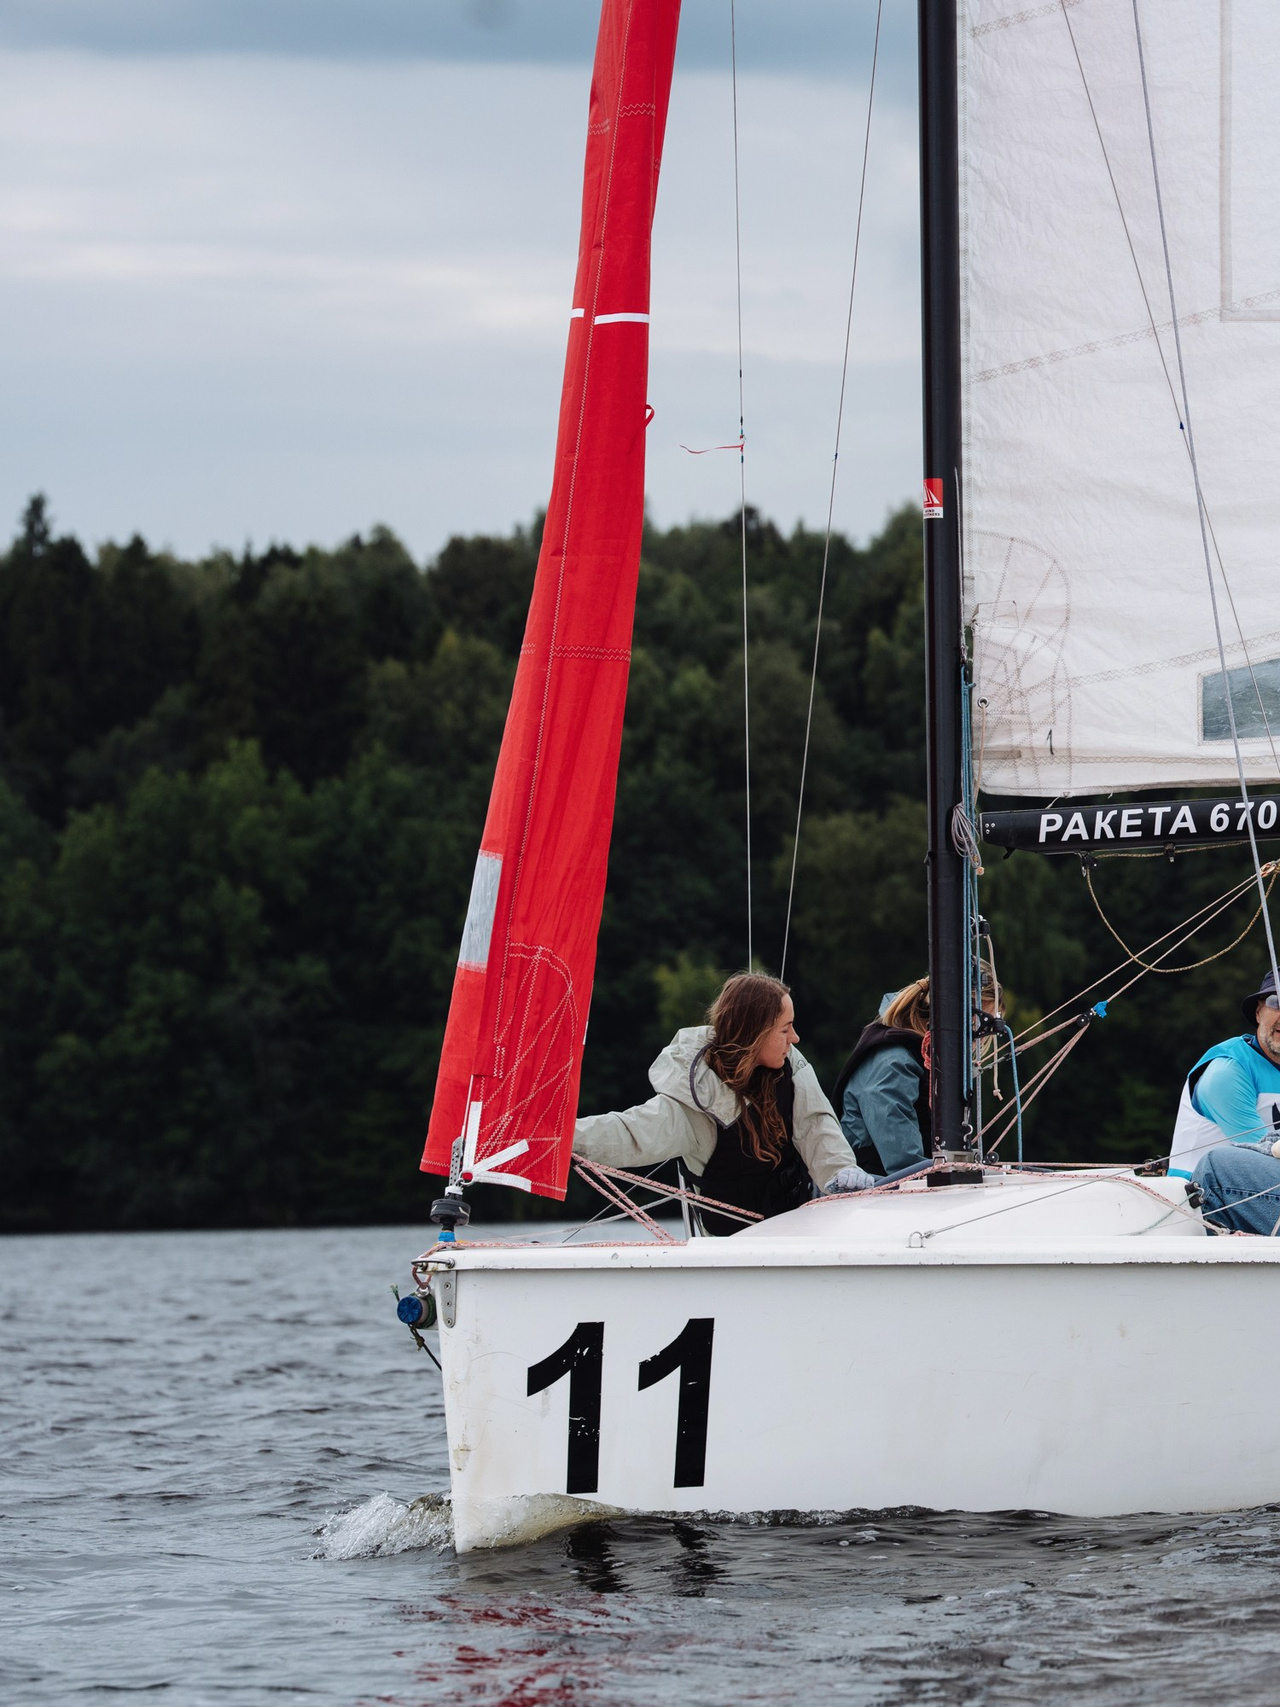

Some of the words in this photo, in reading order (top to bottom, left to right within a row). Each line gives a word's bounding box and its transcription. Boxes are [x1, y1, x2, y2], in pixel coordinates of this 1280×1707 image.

[1039, 806, 1197, 843] РАКЕТА
[1210, 800, 1278, 832] 670
[527, 1318, 714, 1494] 11
